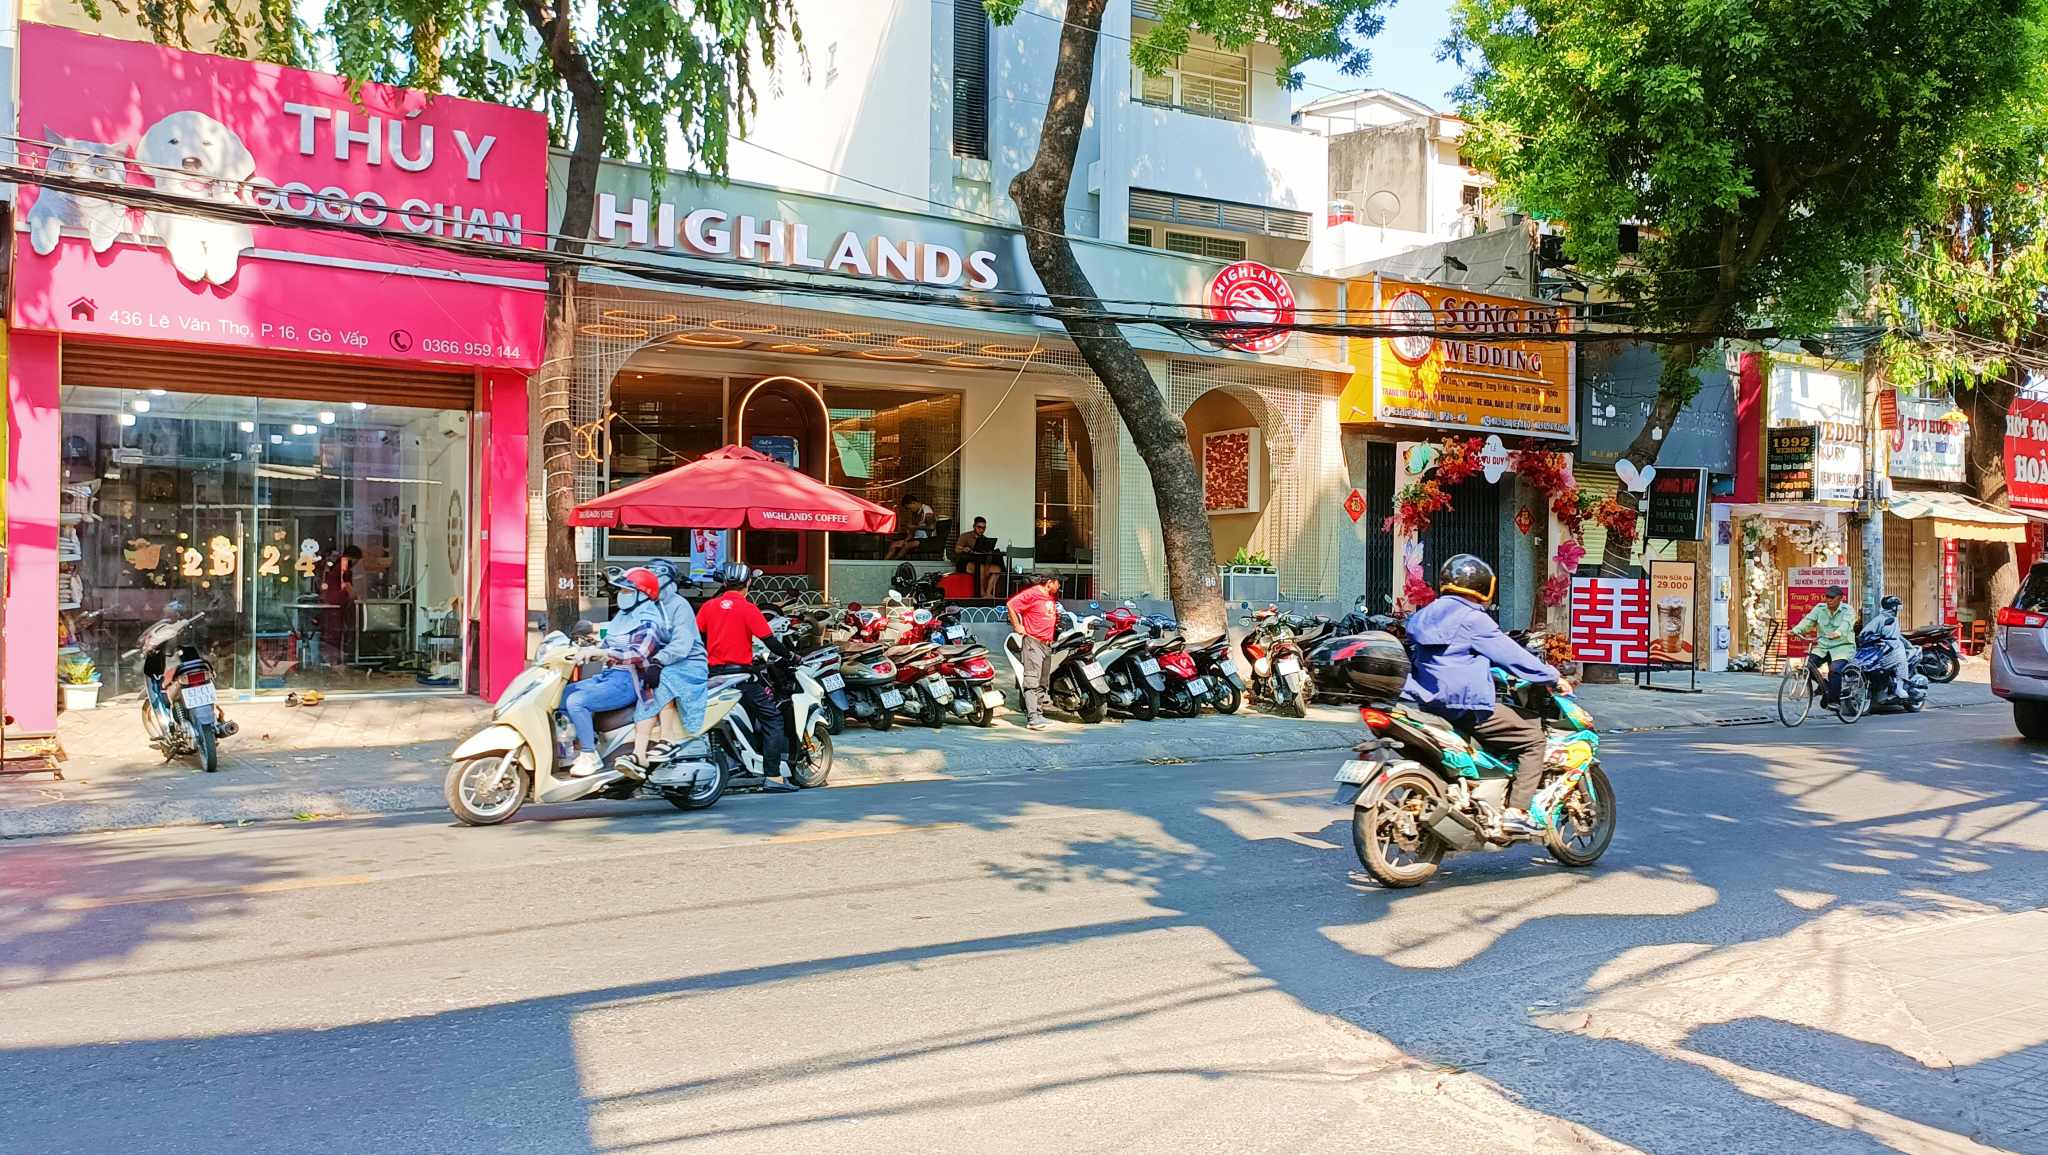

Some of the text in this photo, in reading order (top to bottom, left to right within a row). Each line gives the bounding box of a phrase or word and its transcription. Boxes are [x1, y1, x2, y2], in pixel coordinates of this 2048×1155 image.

[283, 101, 497, 180] THÚ Y
[247, 177, 523, 246] GOGO CHAN
[596, 192, 998, 290] HIGHLANDS
[1215, 266, 1292, 308] HIGHLANDS
[1440, 296, 1520, 334] SONG
[108, 309, 143, 327] 436
[148, 310, 171, 329] Lê
[178, 313, 211, 333] Văn
[217, 318, 255, 338] Thọ,
[307, 326, 333, 344] Gò
[339, 327, 369, 348] Vấp
[422, 338, 521, 360] 0366.959.144
[1441, 339, 1544, 374] WEDDING
[1772, 436, 1811, 448] 1992
[2030, 413, 2048, 442] TÓ
[762, 511, 849, 524] HIGHLANDS COFFEE
[558, 577, 574, 590] 84
[1657, 580, 1689, 590] 29.000
